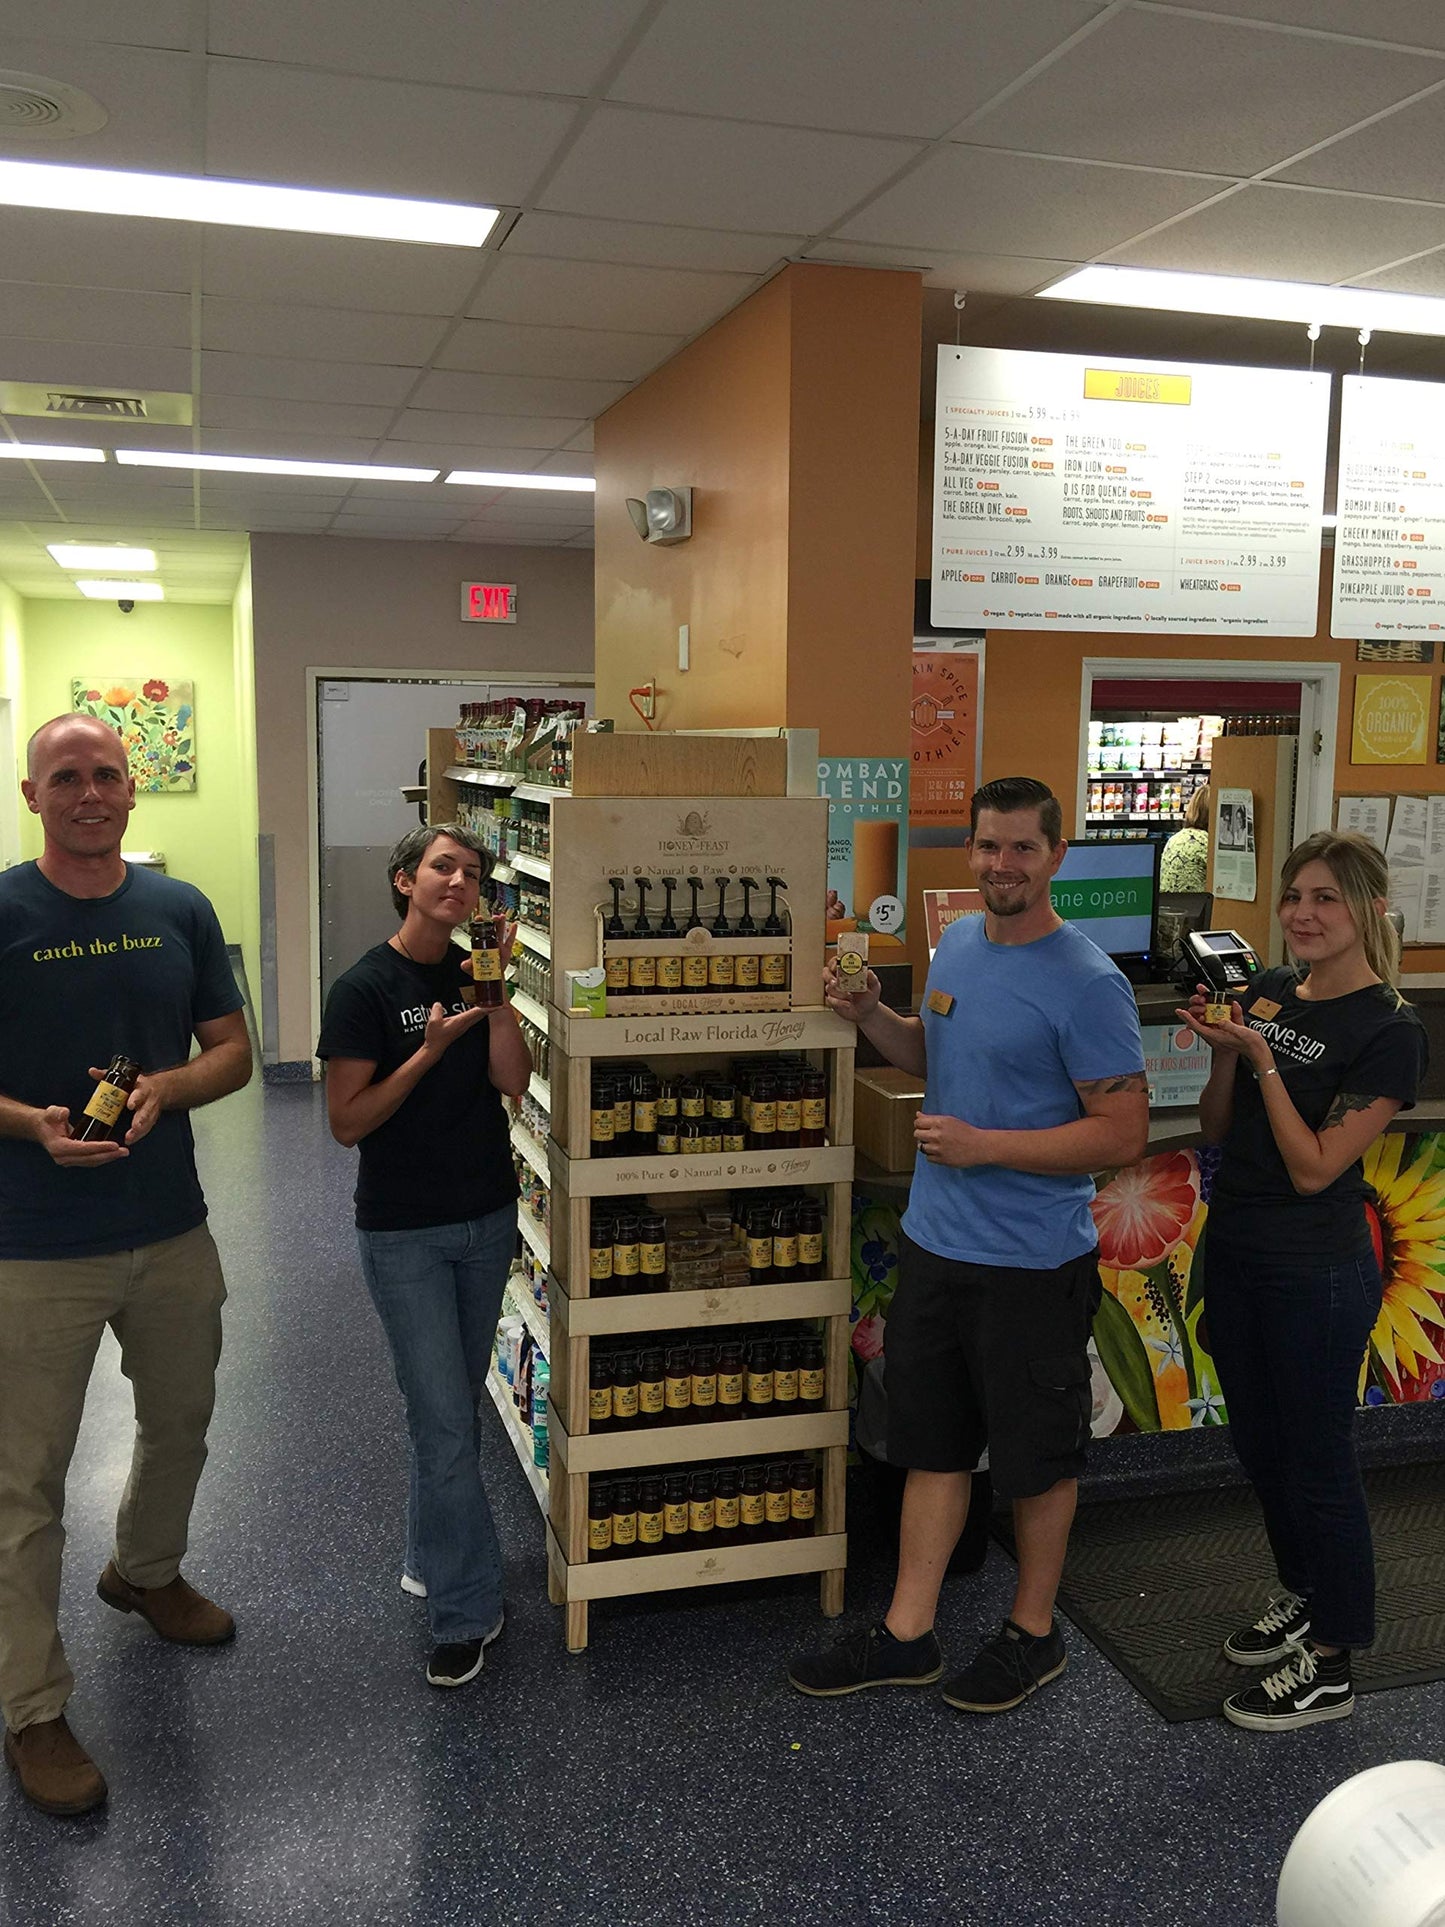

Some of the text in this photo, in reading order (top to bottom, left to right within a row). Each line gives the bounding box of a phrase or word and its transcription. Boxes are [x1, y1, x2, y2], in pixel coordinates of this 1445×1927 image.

[1115, 376, 1160, 400] JUICES
[945, 426, 1028, 444] 5-A-DAY FRUIT FUSION
[1066, 434, 1079, 448] THE
[1082, 436, 1105, 449] GREEN
[944, 451, 1029, 469] 5-A-DAY VEGGIE FUSION
[1064, 459, 1102, 472] IRON LION
[943, 476, 974, 490] ALL VEG
[1184, 471, 1203, 484] STEP
[1215, 478, 1241, 486] CHOOSE
[1248, 480, 1290, 488] INGREDIENTS
[1063, 482, 1127, 498] Q IS FOR QUENCH
[943, 499, 1002, 515] THE GREEN ONE
[1063, 506, 1146, 522] ROOTS, SHOOTS AND FRUITS
[1345, 499, 1396, 513] BOMBAY BLEND
[1343, 527, 1399, 541] CHEEKY MONKEY
[1007, 545, 1025, 558] 2.99
[1041, 546, 1058, 559] 3.99
[1240, 555, 1257, 567] 2.99
[1270, 555, 1287, 567] 3.99
[1341, 555, 1391, 568] GRASSHOPPER
[941, 569, 1139, 589] APPLE CARROT ORANGE GRAPEFRUIT
[1180, 578, 1219, 592] WHEATGRASS
[1340, 582, 1405, 596] PINEAPPLE JULIUS
[469, 585, 512, 619] EXIT
[940, 667, 968, 701] SPICE
[1367, 711, 1417, 733] ORGANIC
[817, 762, 904, 779] OMBAY
[821, 780, 903, 799] LEND
[949, 780, 966, 790] 6.50
[949, 791, 964, 800] 7.50
[828, 804, 903, 813] OOTHIE
[700, 840, 731, 851] FEAST
[602, 864, 787, 876] Local Natural Raw 100% Pure
[1049, 890, 1137, 909] ane open
[937, 909, 986, 923] PUMP
[33, 933, 163, 963] catch the buzz
[672, 999, 698, 1010] LOCAL
[624, 1018, 807, 1047] Local Raw Florida Honey
[1270, 1042, 1291, 1056] FOODS
[1293, 1035, 1326, 1060] sun
[1179, 1055, 1209, 1071] ACTIVITY
[616, 1159, 812, 1182] 100% Pure Natural Raw Honey
